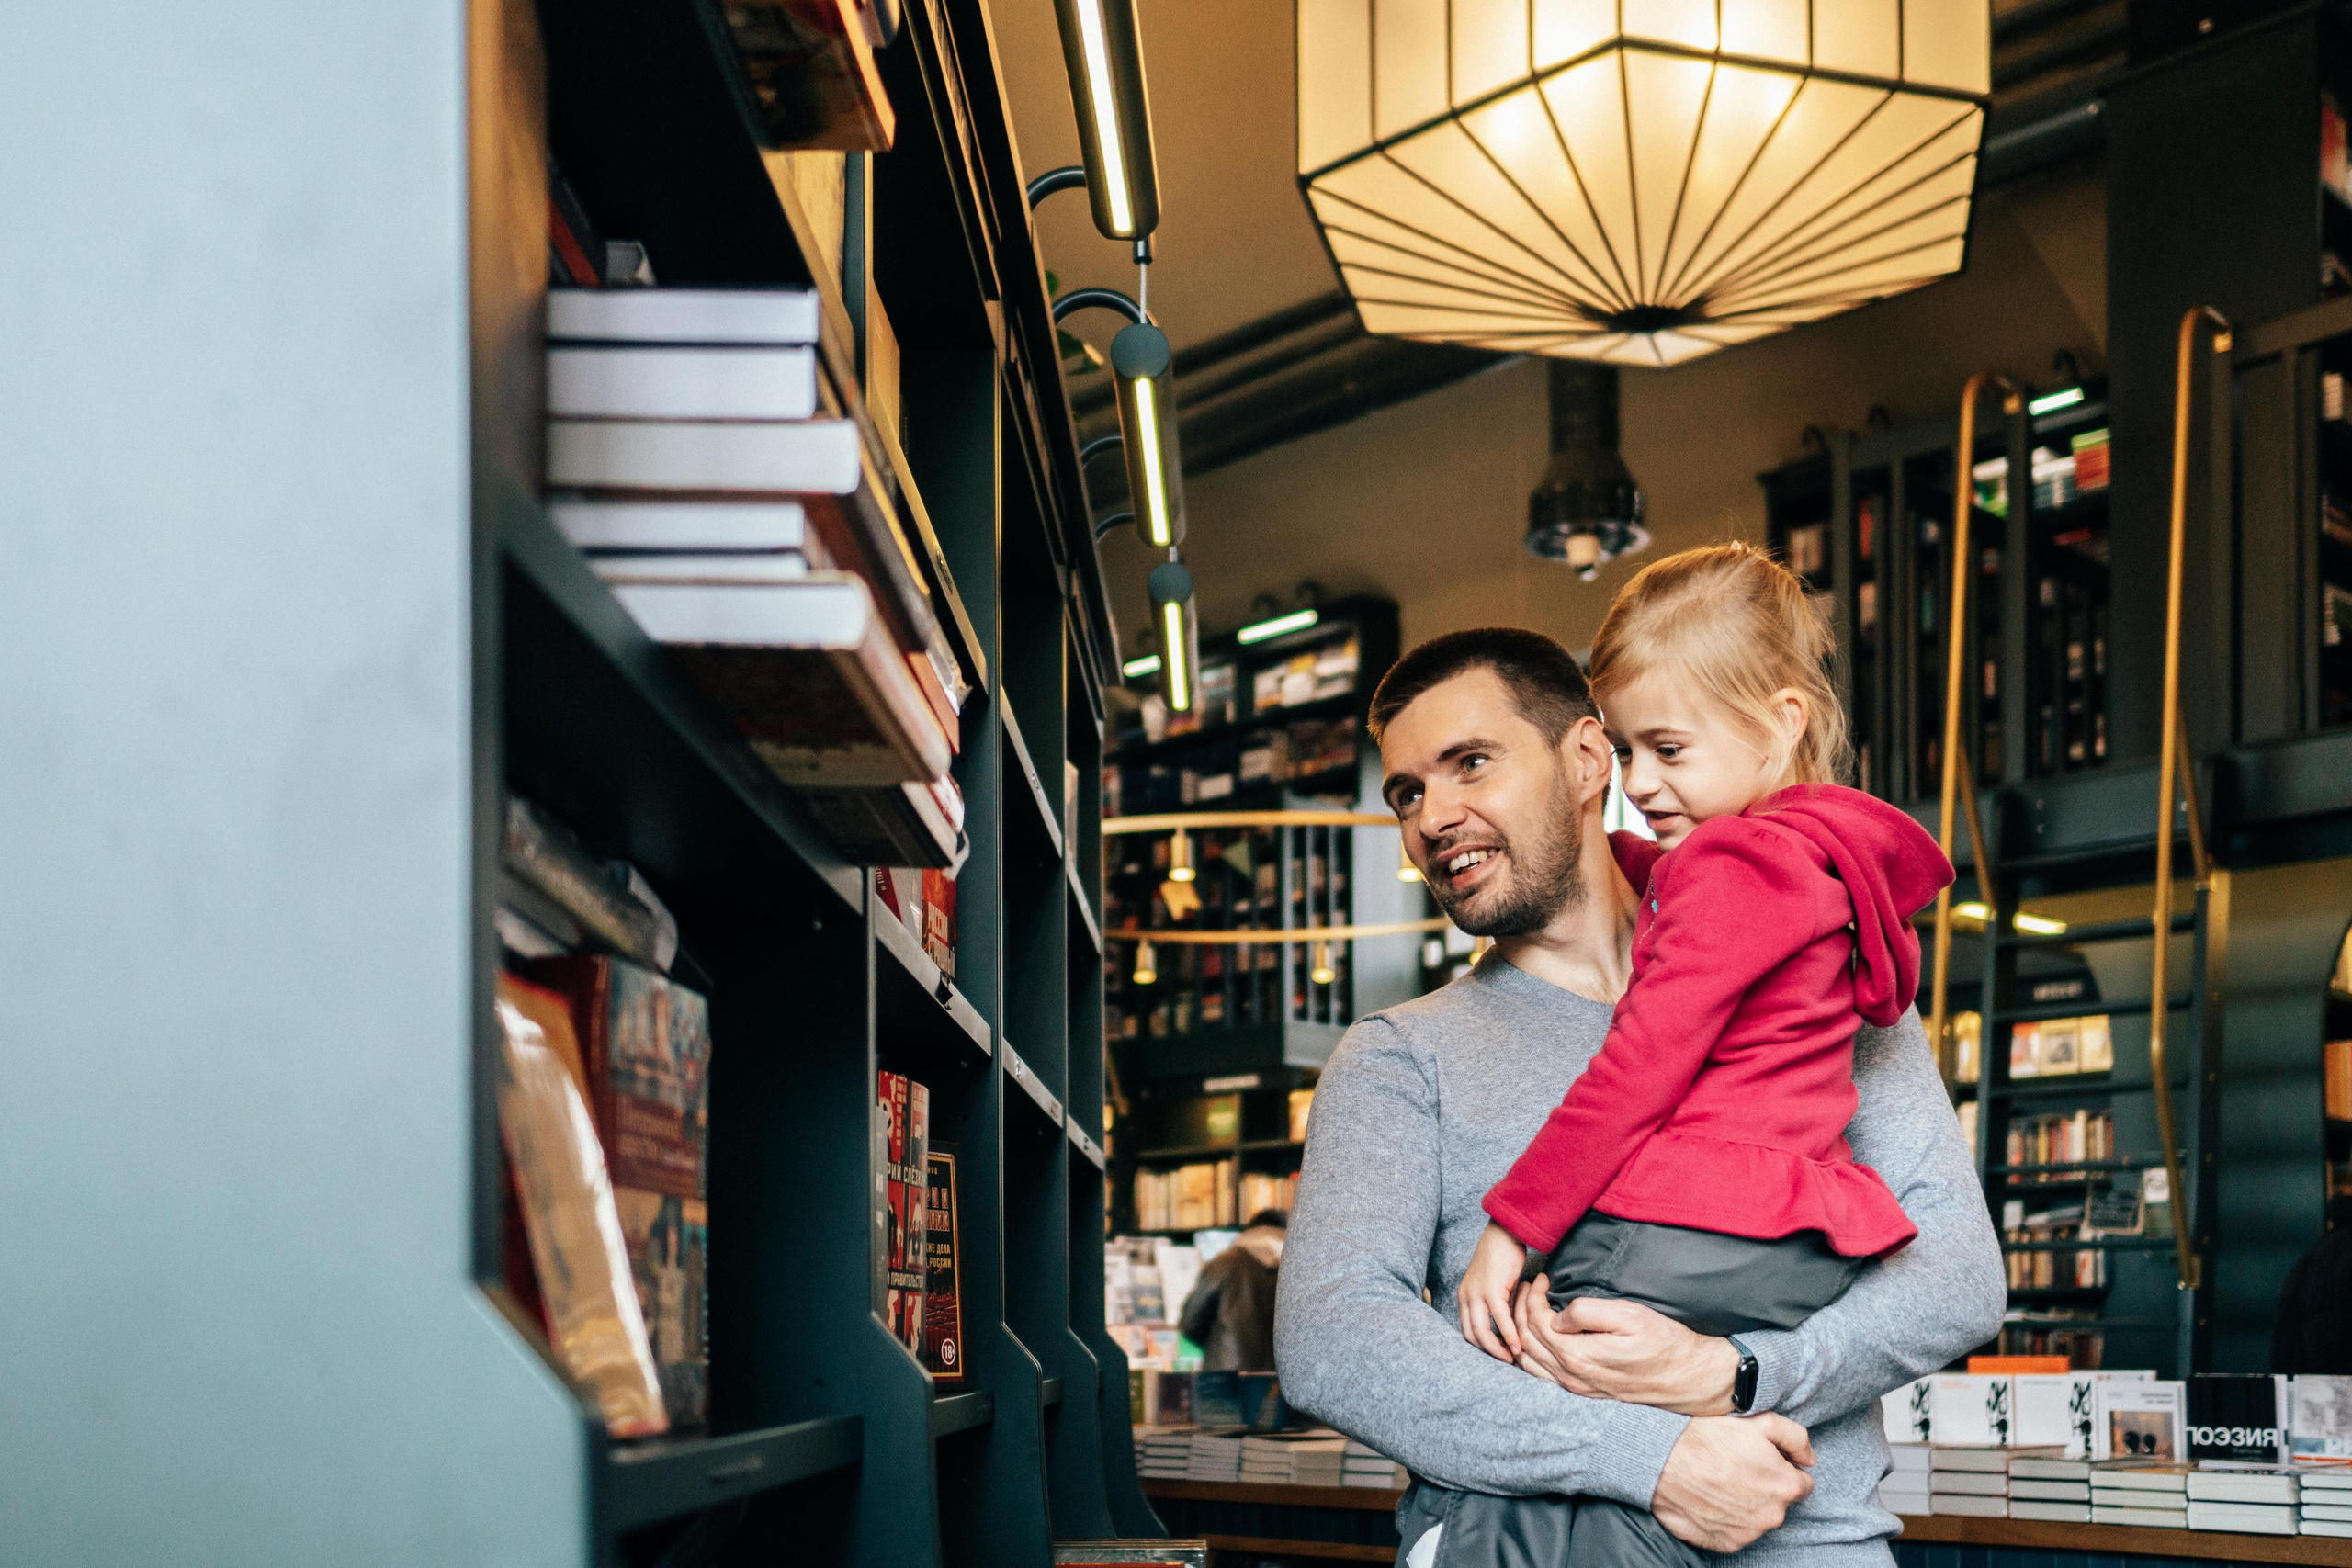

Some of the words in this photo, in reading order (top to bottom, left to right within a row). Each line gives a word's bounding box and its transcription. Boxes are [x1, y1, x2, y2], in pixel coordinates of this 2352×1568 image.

[888, 1160, 901, 1179] РИЙ
[936, 1243, 951, 1255] ДЕЛА
[929, 1257, 952, 1269] РОССИИ
[944, 1345, 956, 1359] 18+
[2185, 1425, 2279, 1448] ПОЭЗИЯ
